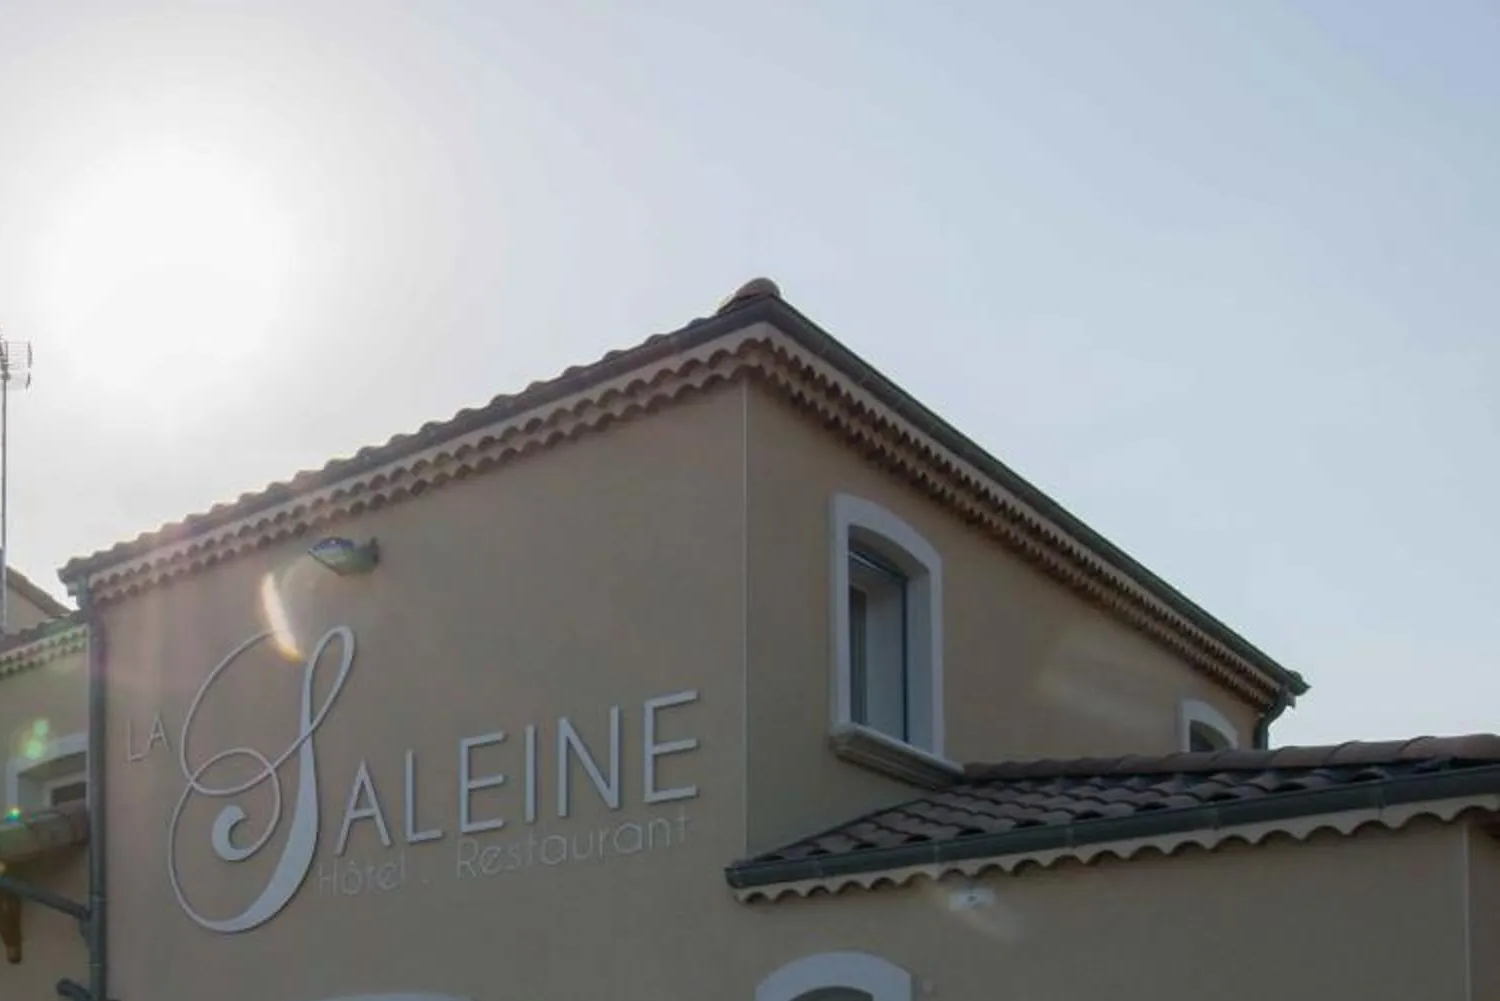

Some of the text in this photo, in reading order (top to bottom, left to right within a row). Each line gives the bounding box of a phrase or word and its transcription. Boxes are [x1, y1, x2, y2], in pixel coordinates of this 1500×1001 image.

[125, 625, 699, 933] LA SALEINE
[456, 809, 693, 881] Restaurant
